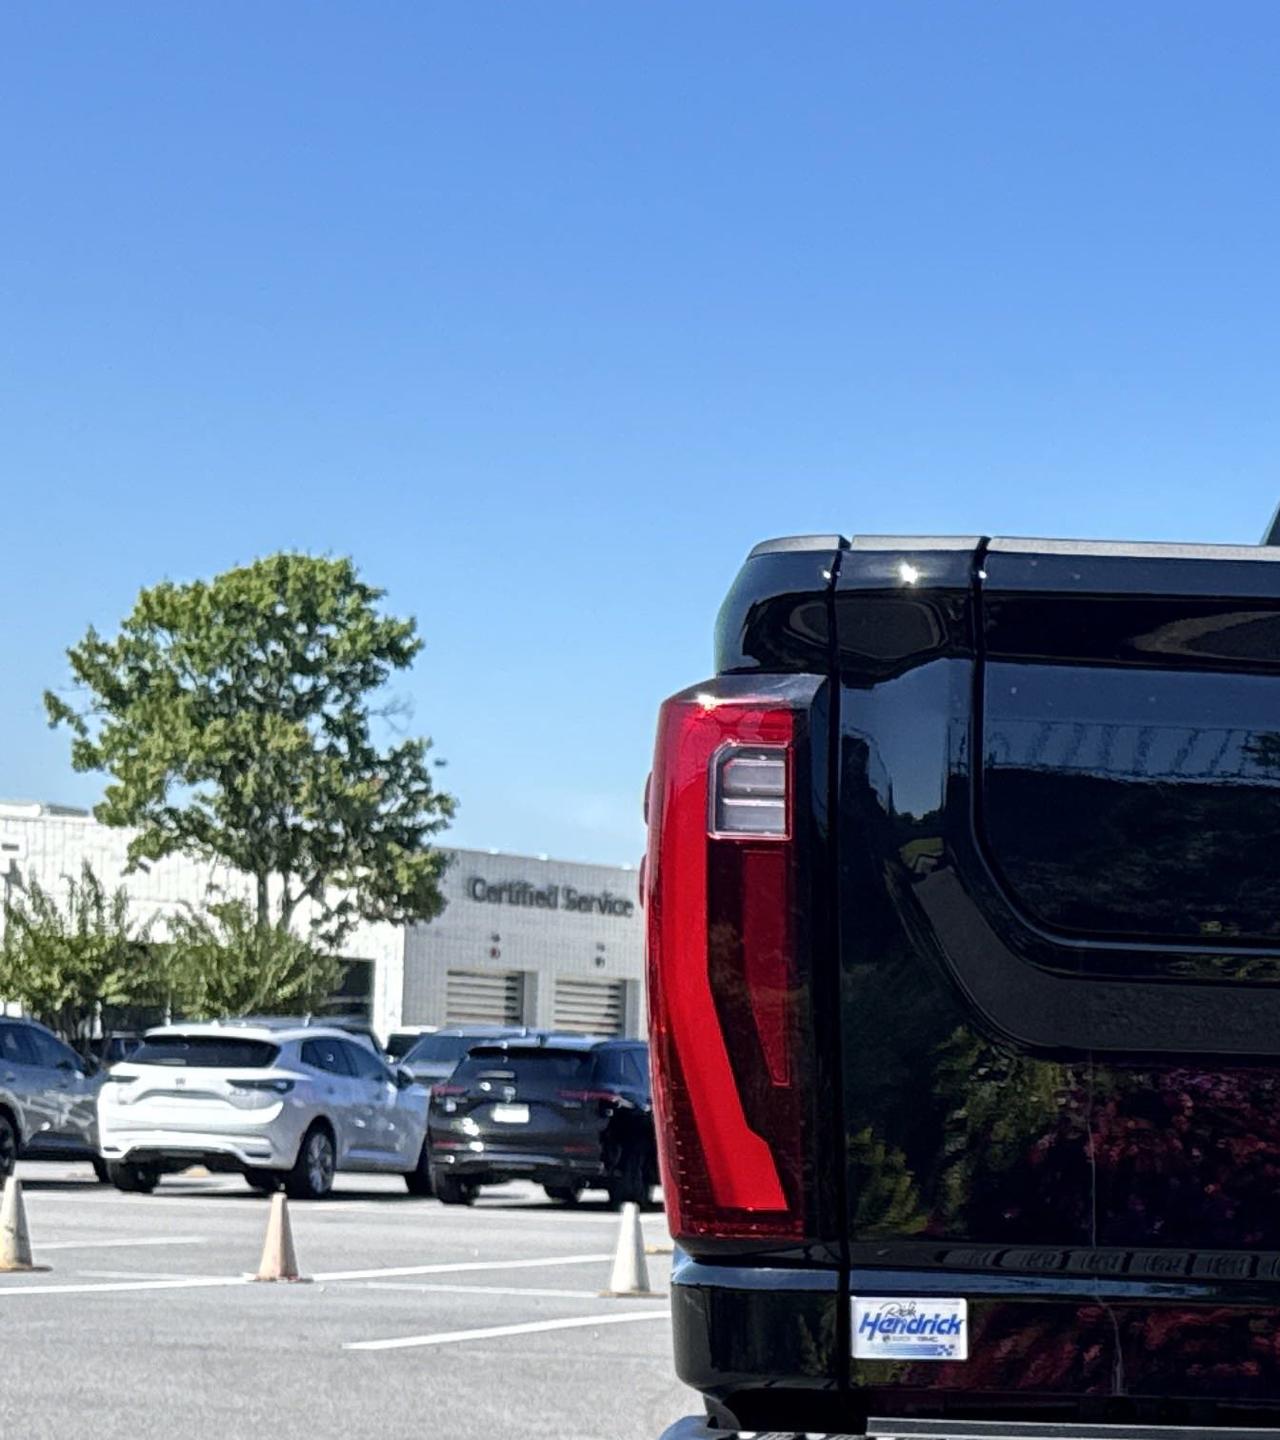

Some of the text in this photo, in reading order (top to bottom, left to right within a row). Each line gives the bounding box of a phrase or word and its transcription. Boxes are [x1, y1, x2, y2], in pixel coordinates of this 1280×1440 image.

[468, 876, 635, 918] Certified Service
[859, 1312, 965, 1341] Hendrick
